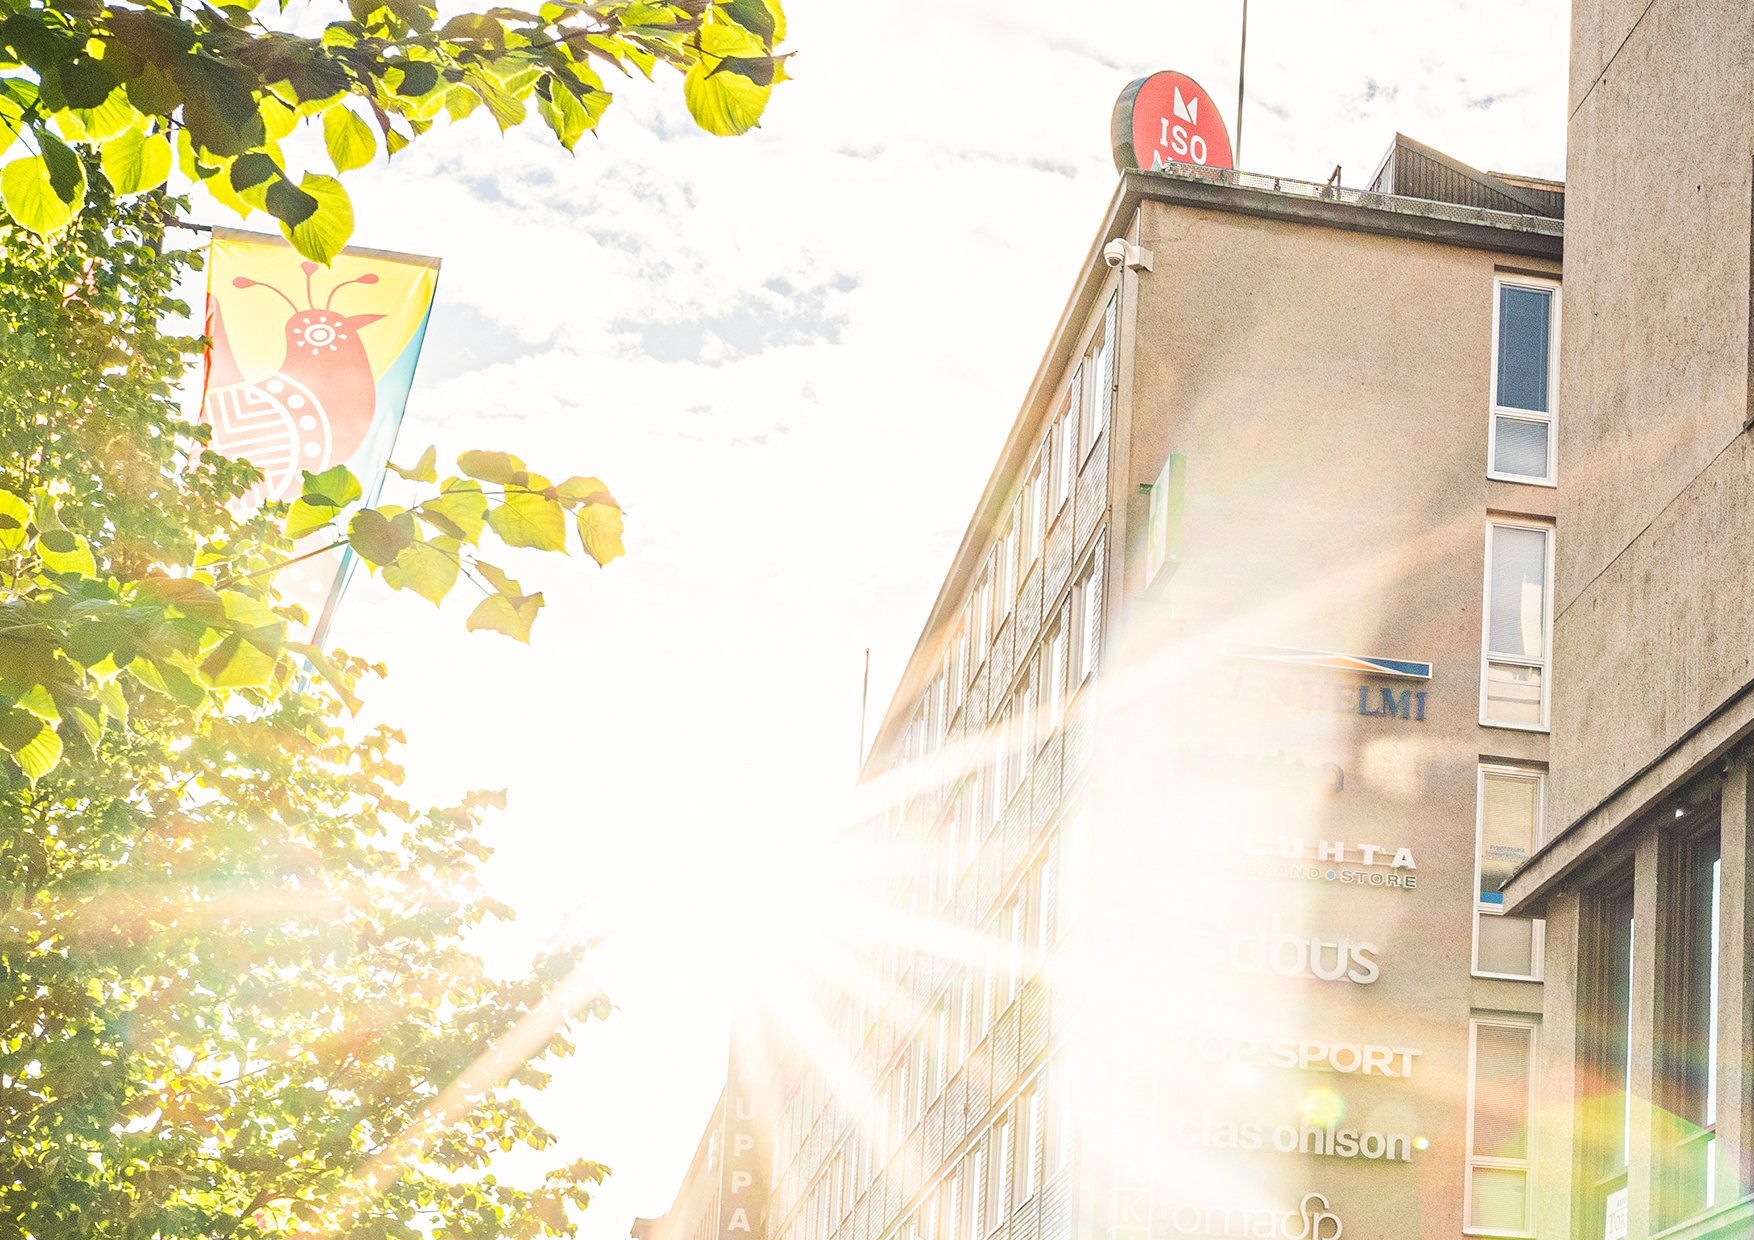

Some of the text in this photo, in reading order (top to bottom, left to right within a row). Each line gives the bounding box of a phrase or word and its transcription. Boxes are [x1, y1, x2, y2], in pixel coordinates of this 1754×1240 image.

[1160, 117, 1207, 165] ISO
[1340, 869, 1417, 889] STORE
[1267, 1038, 1423, 1078] SPORT
[1272, 1118, 1413, 1161] ohlson
